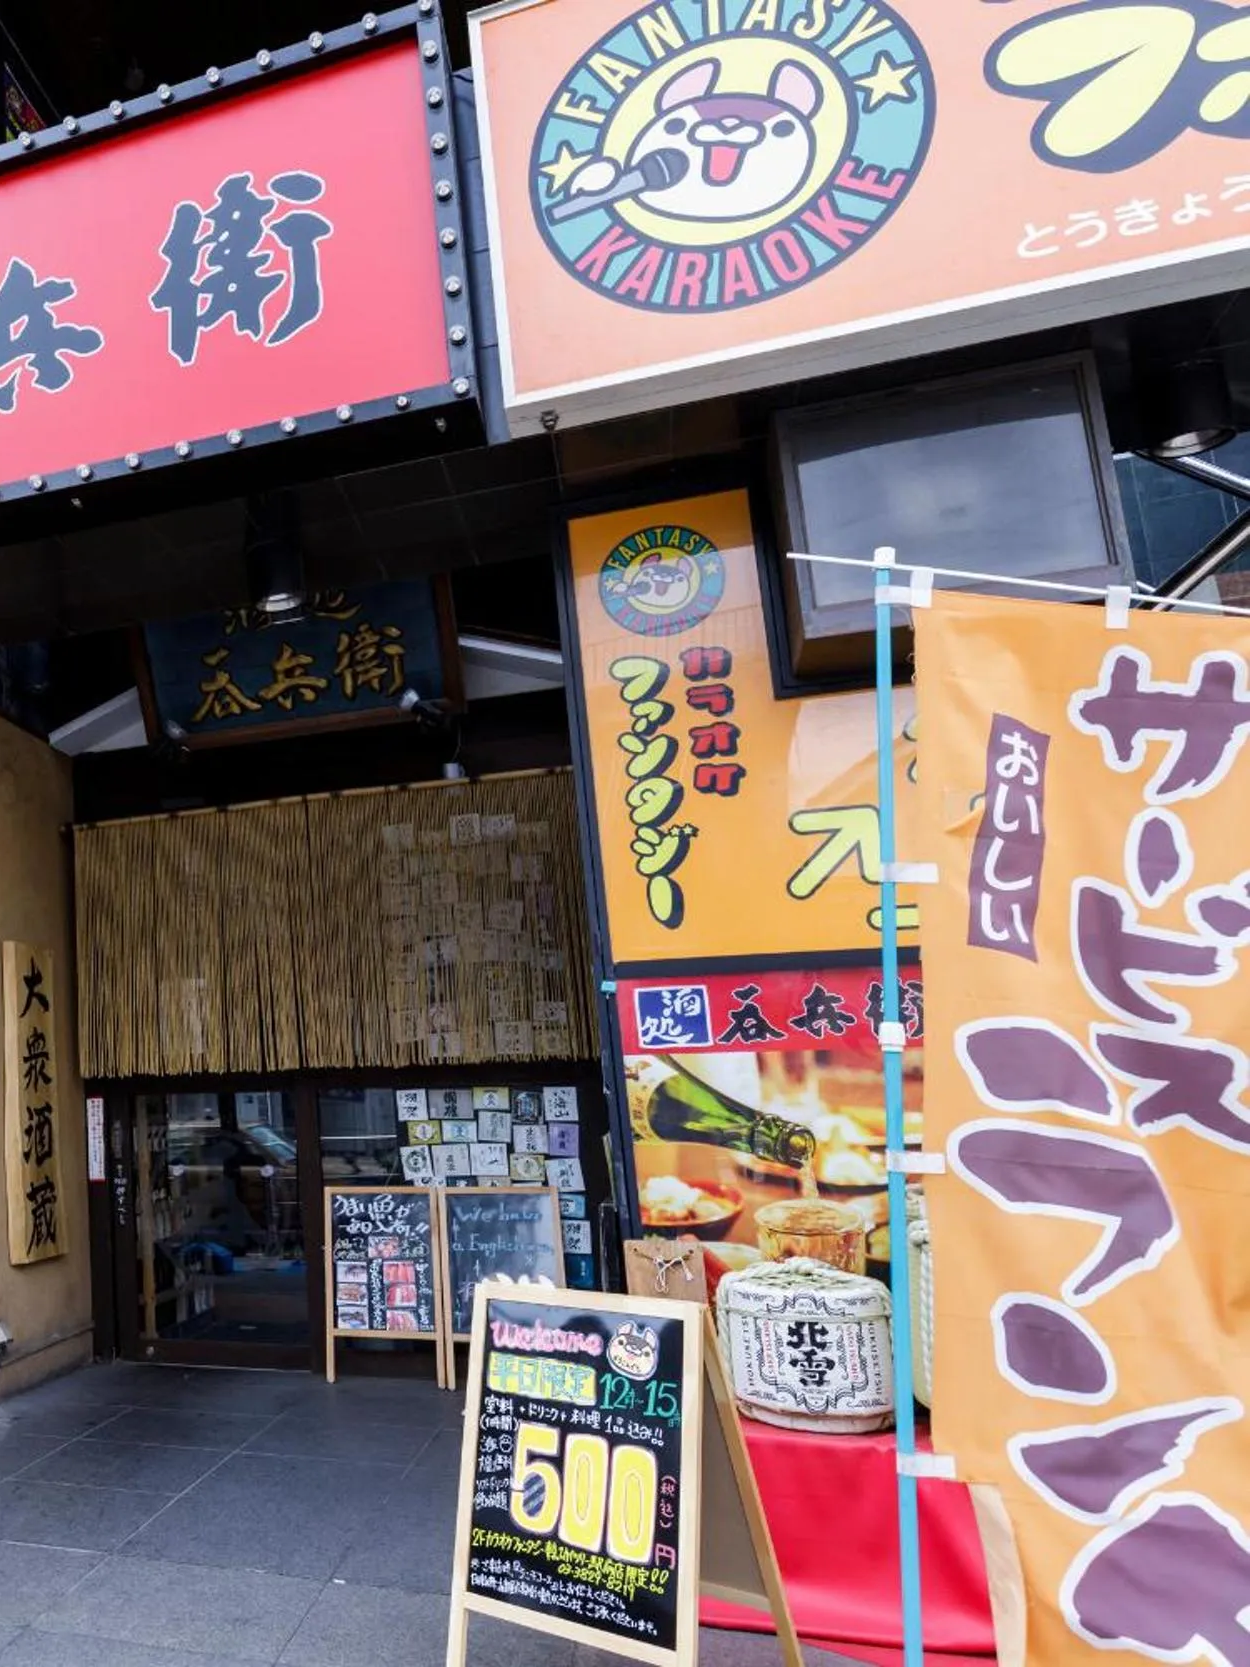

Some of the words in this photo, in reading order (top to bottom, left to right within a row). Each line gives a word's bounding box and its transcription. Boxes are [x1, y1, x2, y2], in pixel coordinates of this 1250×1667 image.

[553, 0, 893, 124] FANTASY
[575, 159, 906, 307] KARAOKE
[1017, 174, 1250, 257] とうきょう
[608, 527, 714, 571] FANTASY
[190, 621, 405, 723] 呑兵衛
[680, 646, 746, 797] カラオケ
[609, 655, 699, 930] ファンタジー
[980, 730, 1040, 944] おいしい
[19, 957, 57, 1257] 大衆酒蔵
[786, 1321, 836, 1387] 北雪
[510, 1418, 656, 1566] 500
[654, 1542, 677, 1570] 円
